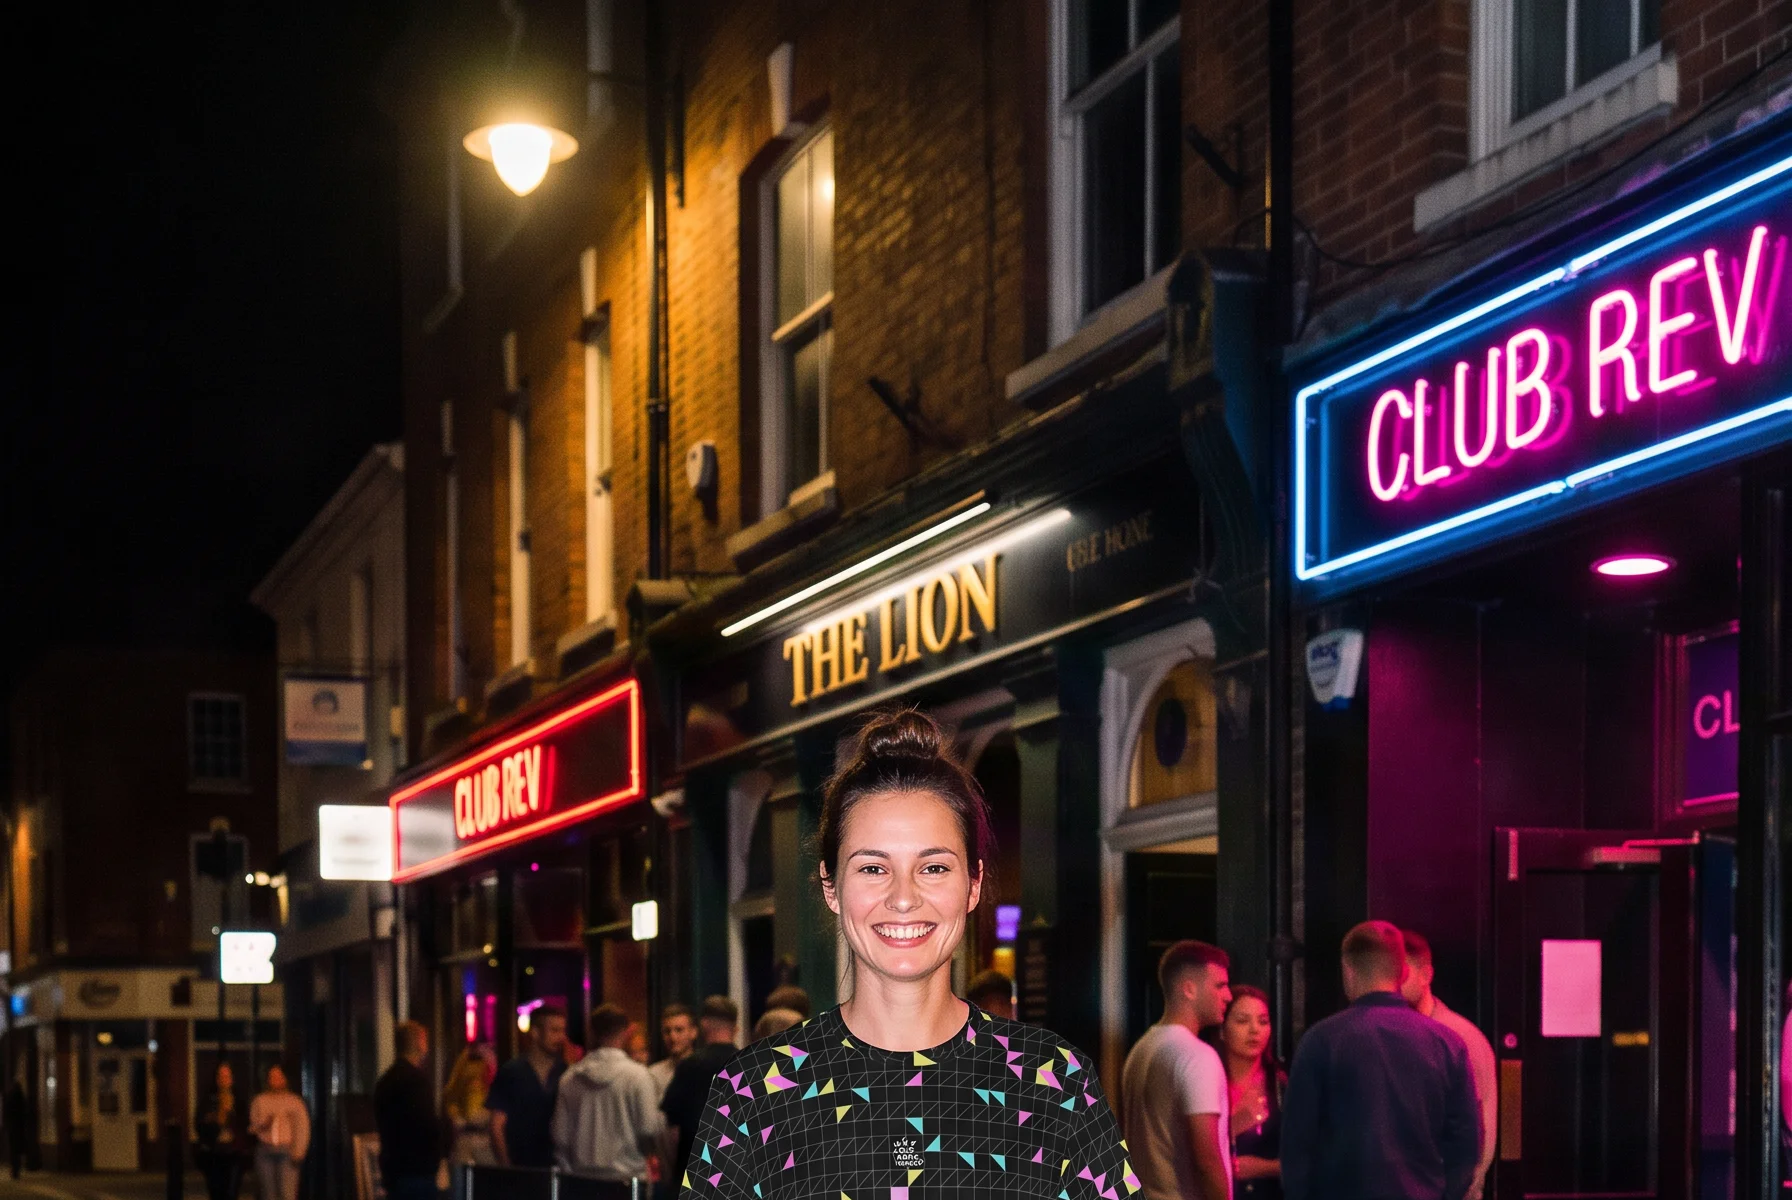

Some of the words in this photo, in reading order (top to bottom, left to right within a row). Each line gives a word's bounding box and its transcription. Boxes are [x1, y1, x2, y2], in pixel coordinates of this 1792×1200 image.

[1367, 328, 1551, 502] CLUB
[1588, 225, 1768, 418] REV
[782, 612, 869, 708] THE
[878, 553, 998, 673] LION
[455, 764, 501, 839] CLUB
[502, 744, 541, 821] REV
